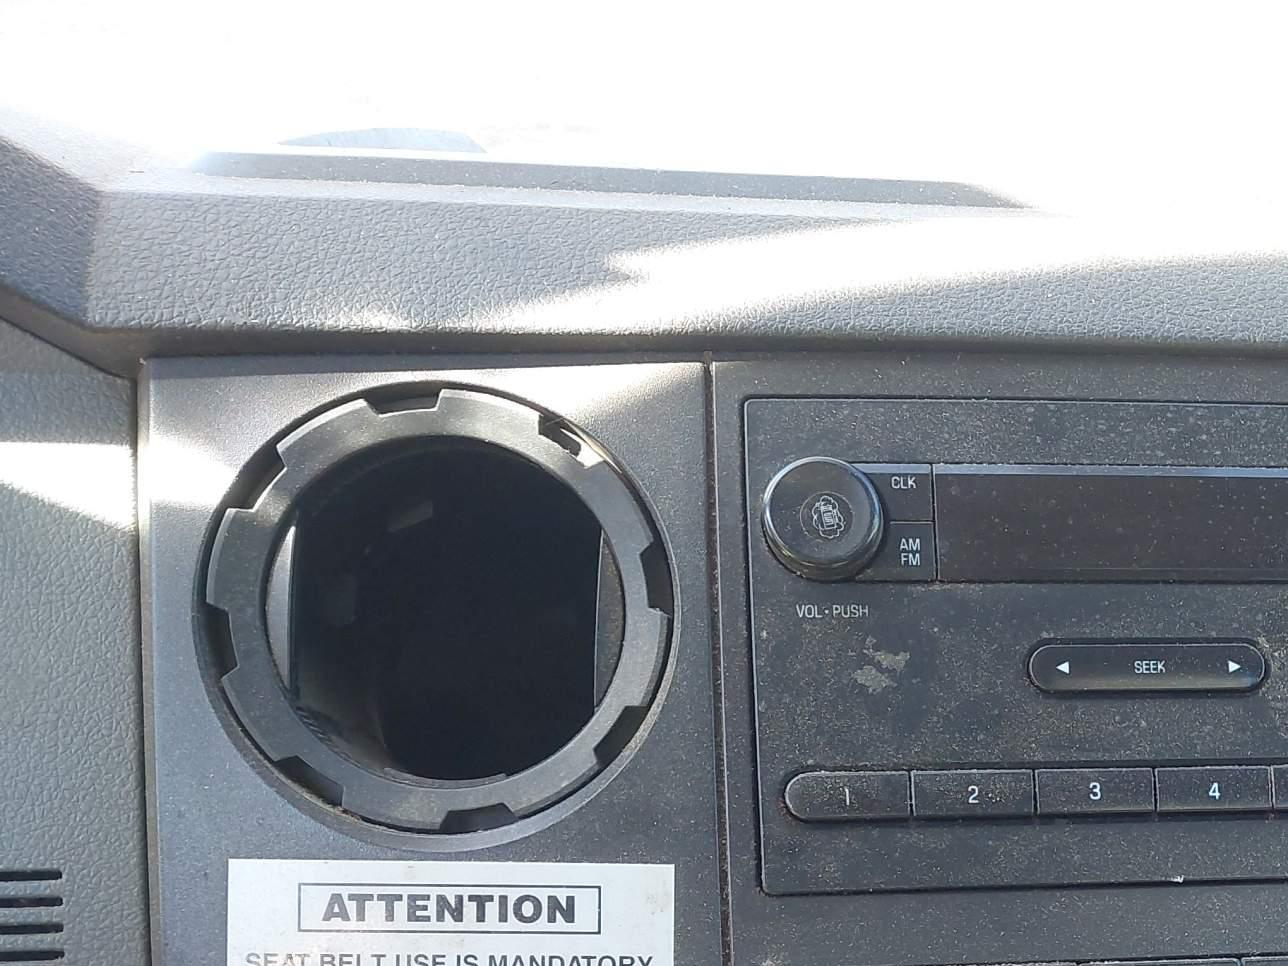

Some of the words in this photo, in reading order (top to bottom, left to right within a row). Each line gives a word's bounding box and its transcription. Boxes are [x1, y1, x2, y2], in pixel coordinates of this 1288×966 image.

[891, 476, 917, 489] CLK
[900, 538, 921, 551] AM
[901, 553, 921, 566] FM
[796, 604, 823, 618] VOL
[832, 604, 869, 618] PUSH
[1133, 660, 1166, 675] SEEK
[843, 788, 851, 806] 1
[967, 785, 980, 804] 2
[1088, 782, 1102, 801] 3
[1208, 781, 1222, 801] 4
[321, 893, 576, 924] ATTENTION
